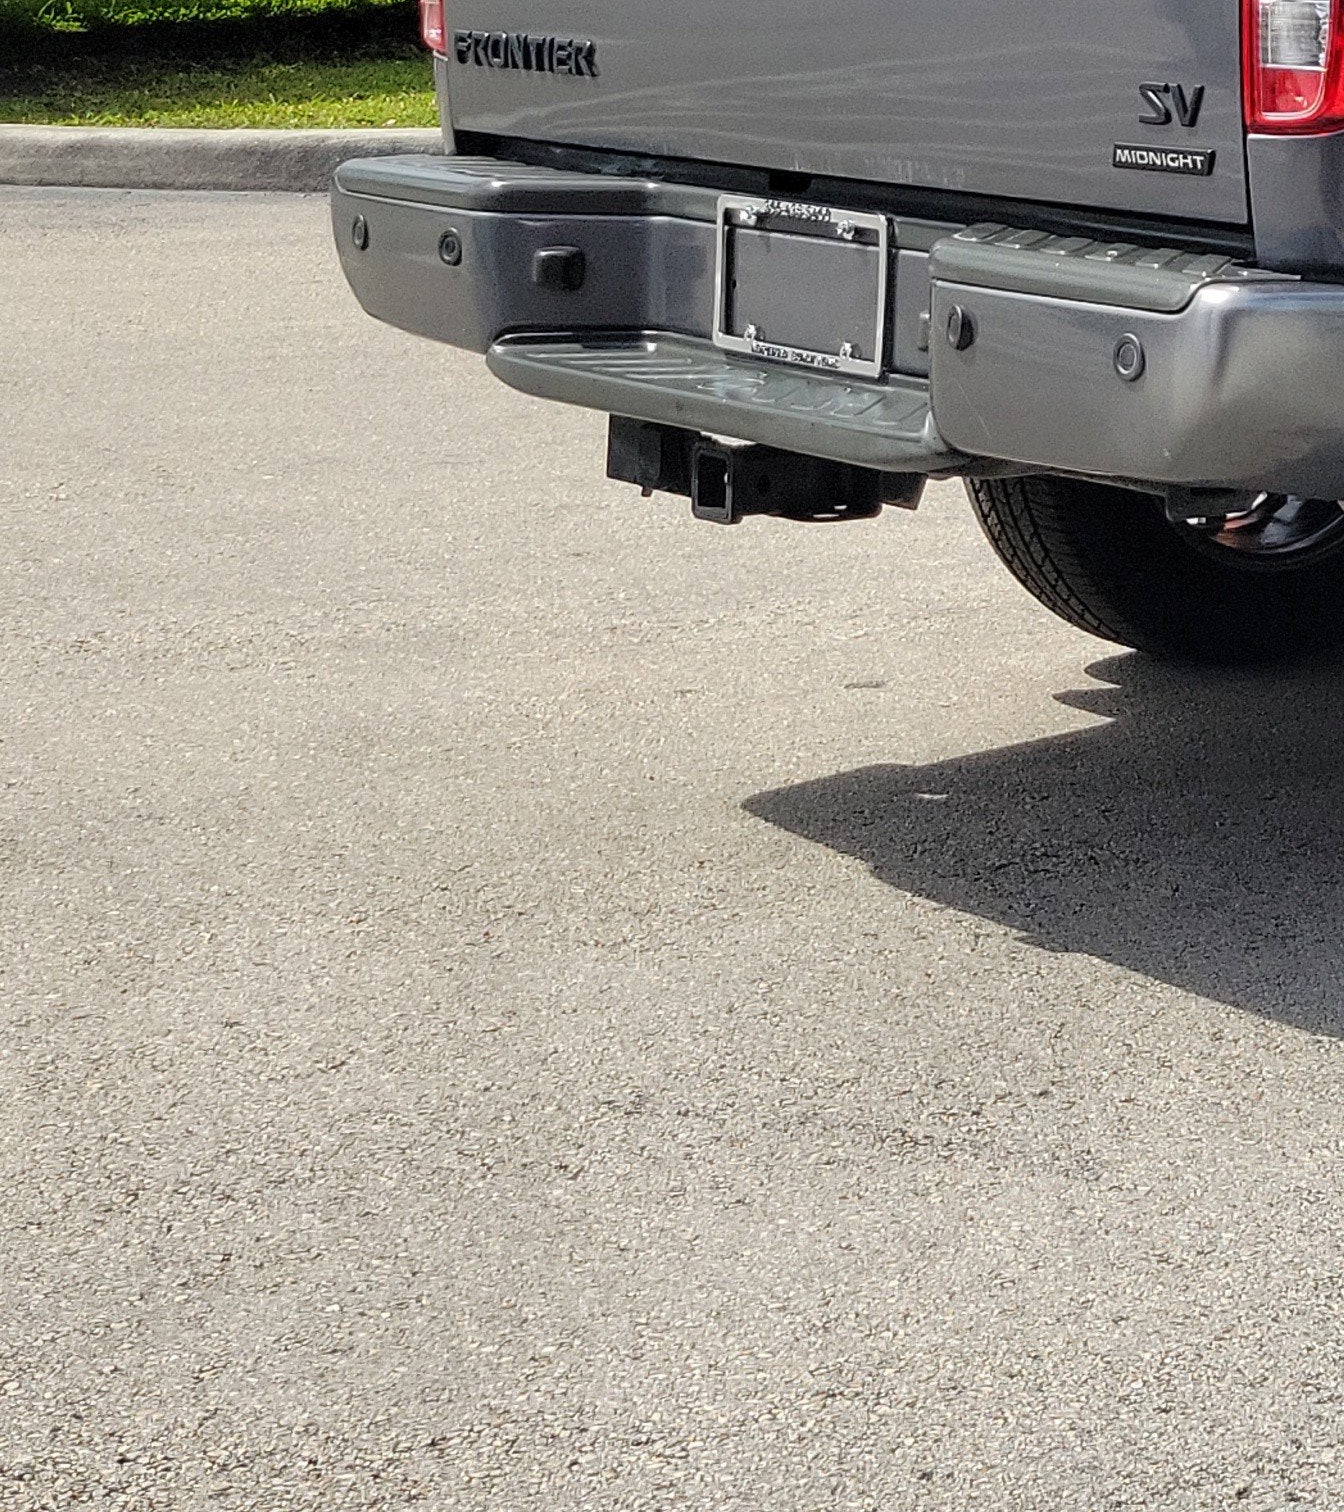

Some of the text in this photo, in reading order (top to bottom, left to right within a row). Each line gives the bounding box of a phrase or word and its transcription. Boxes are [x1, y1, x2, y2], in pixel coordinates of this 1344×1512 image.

[454, 29, 601, 78] FRONTIER
[1138, 81, 1205, 128] SV
[1115, 148, 1206, 171] MIDNIGHT
